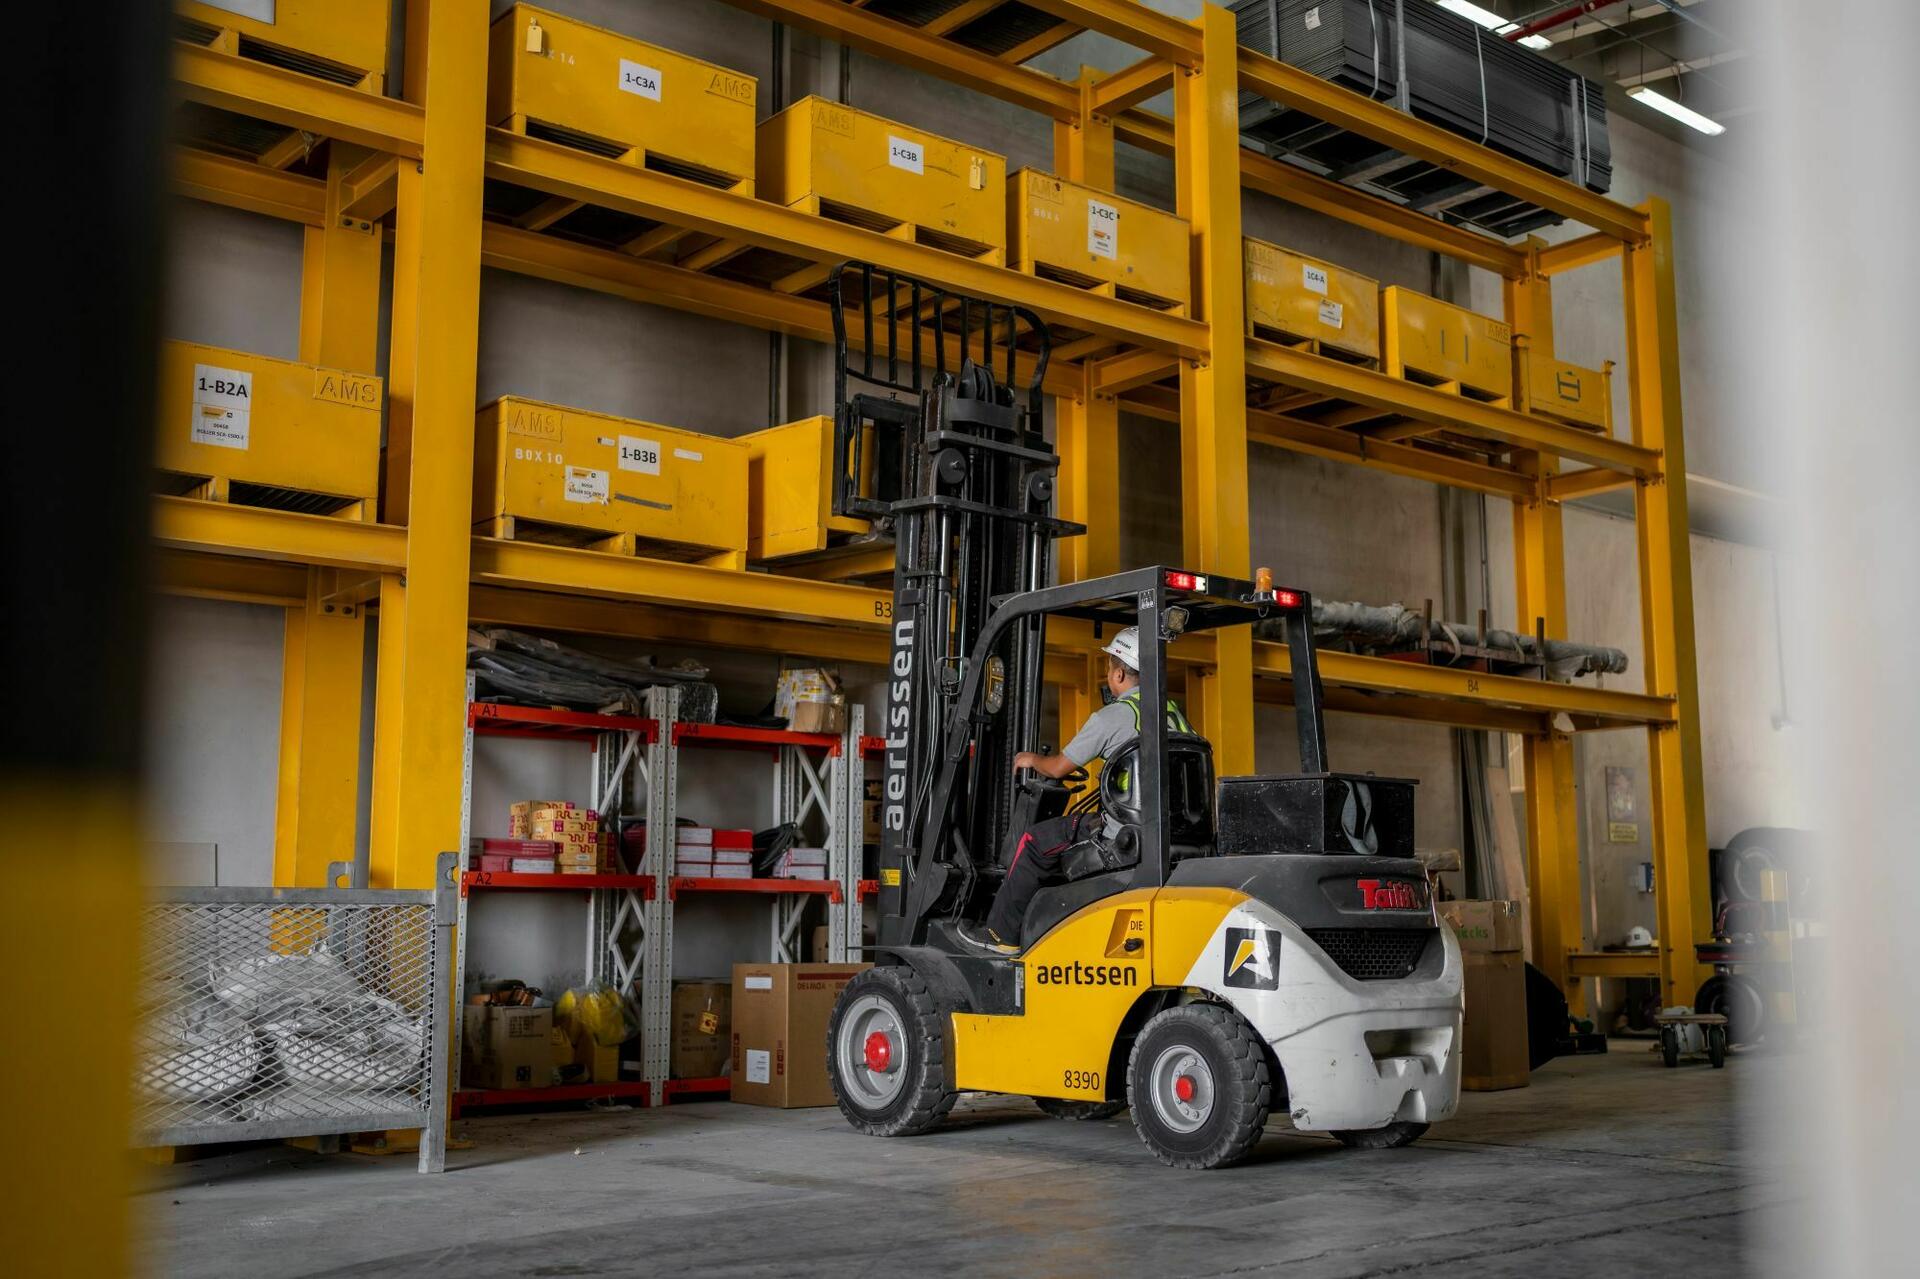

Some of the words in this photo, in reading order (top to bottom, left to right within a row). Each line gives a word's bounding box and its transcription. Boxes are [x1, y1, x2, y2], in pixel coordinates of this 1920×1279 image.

[626, 72, 656, 91] 1-C3A
[710, 74, 752, 99] AMS
[817, 105, 850, 130] AMS
[892, 147, 917, 162] 1-C3B
[1092, 206, 1114, 221] 1-C3C
[198, 377, 248, 398] 1-B2A
[320, 376, 376, 402] AMS
[513, 409, 556, 433] AMS
[548, 452, 563, 465] 10
[621, 447, 657, 464] 1-B3B
[875, 600, 893, 618] B3
[1467, 679, 1480, 692] B4
[481, 703, 499, 717] A1
[886, 619, 914, 831] aertssen
[869, 737, 884, 748] A7
[475, 872, 492, 885] A2
[1037, 960, 1137, 986] aertssen
[1064, 1069, 1100, 1090] 8390
